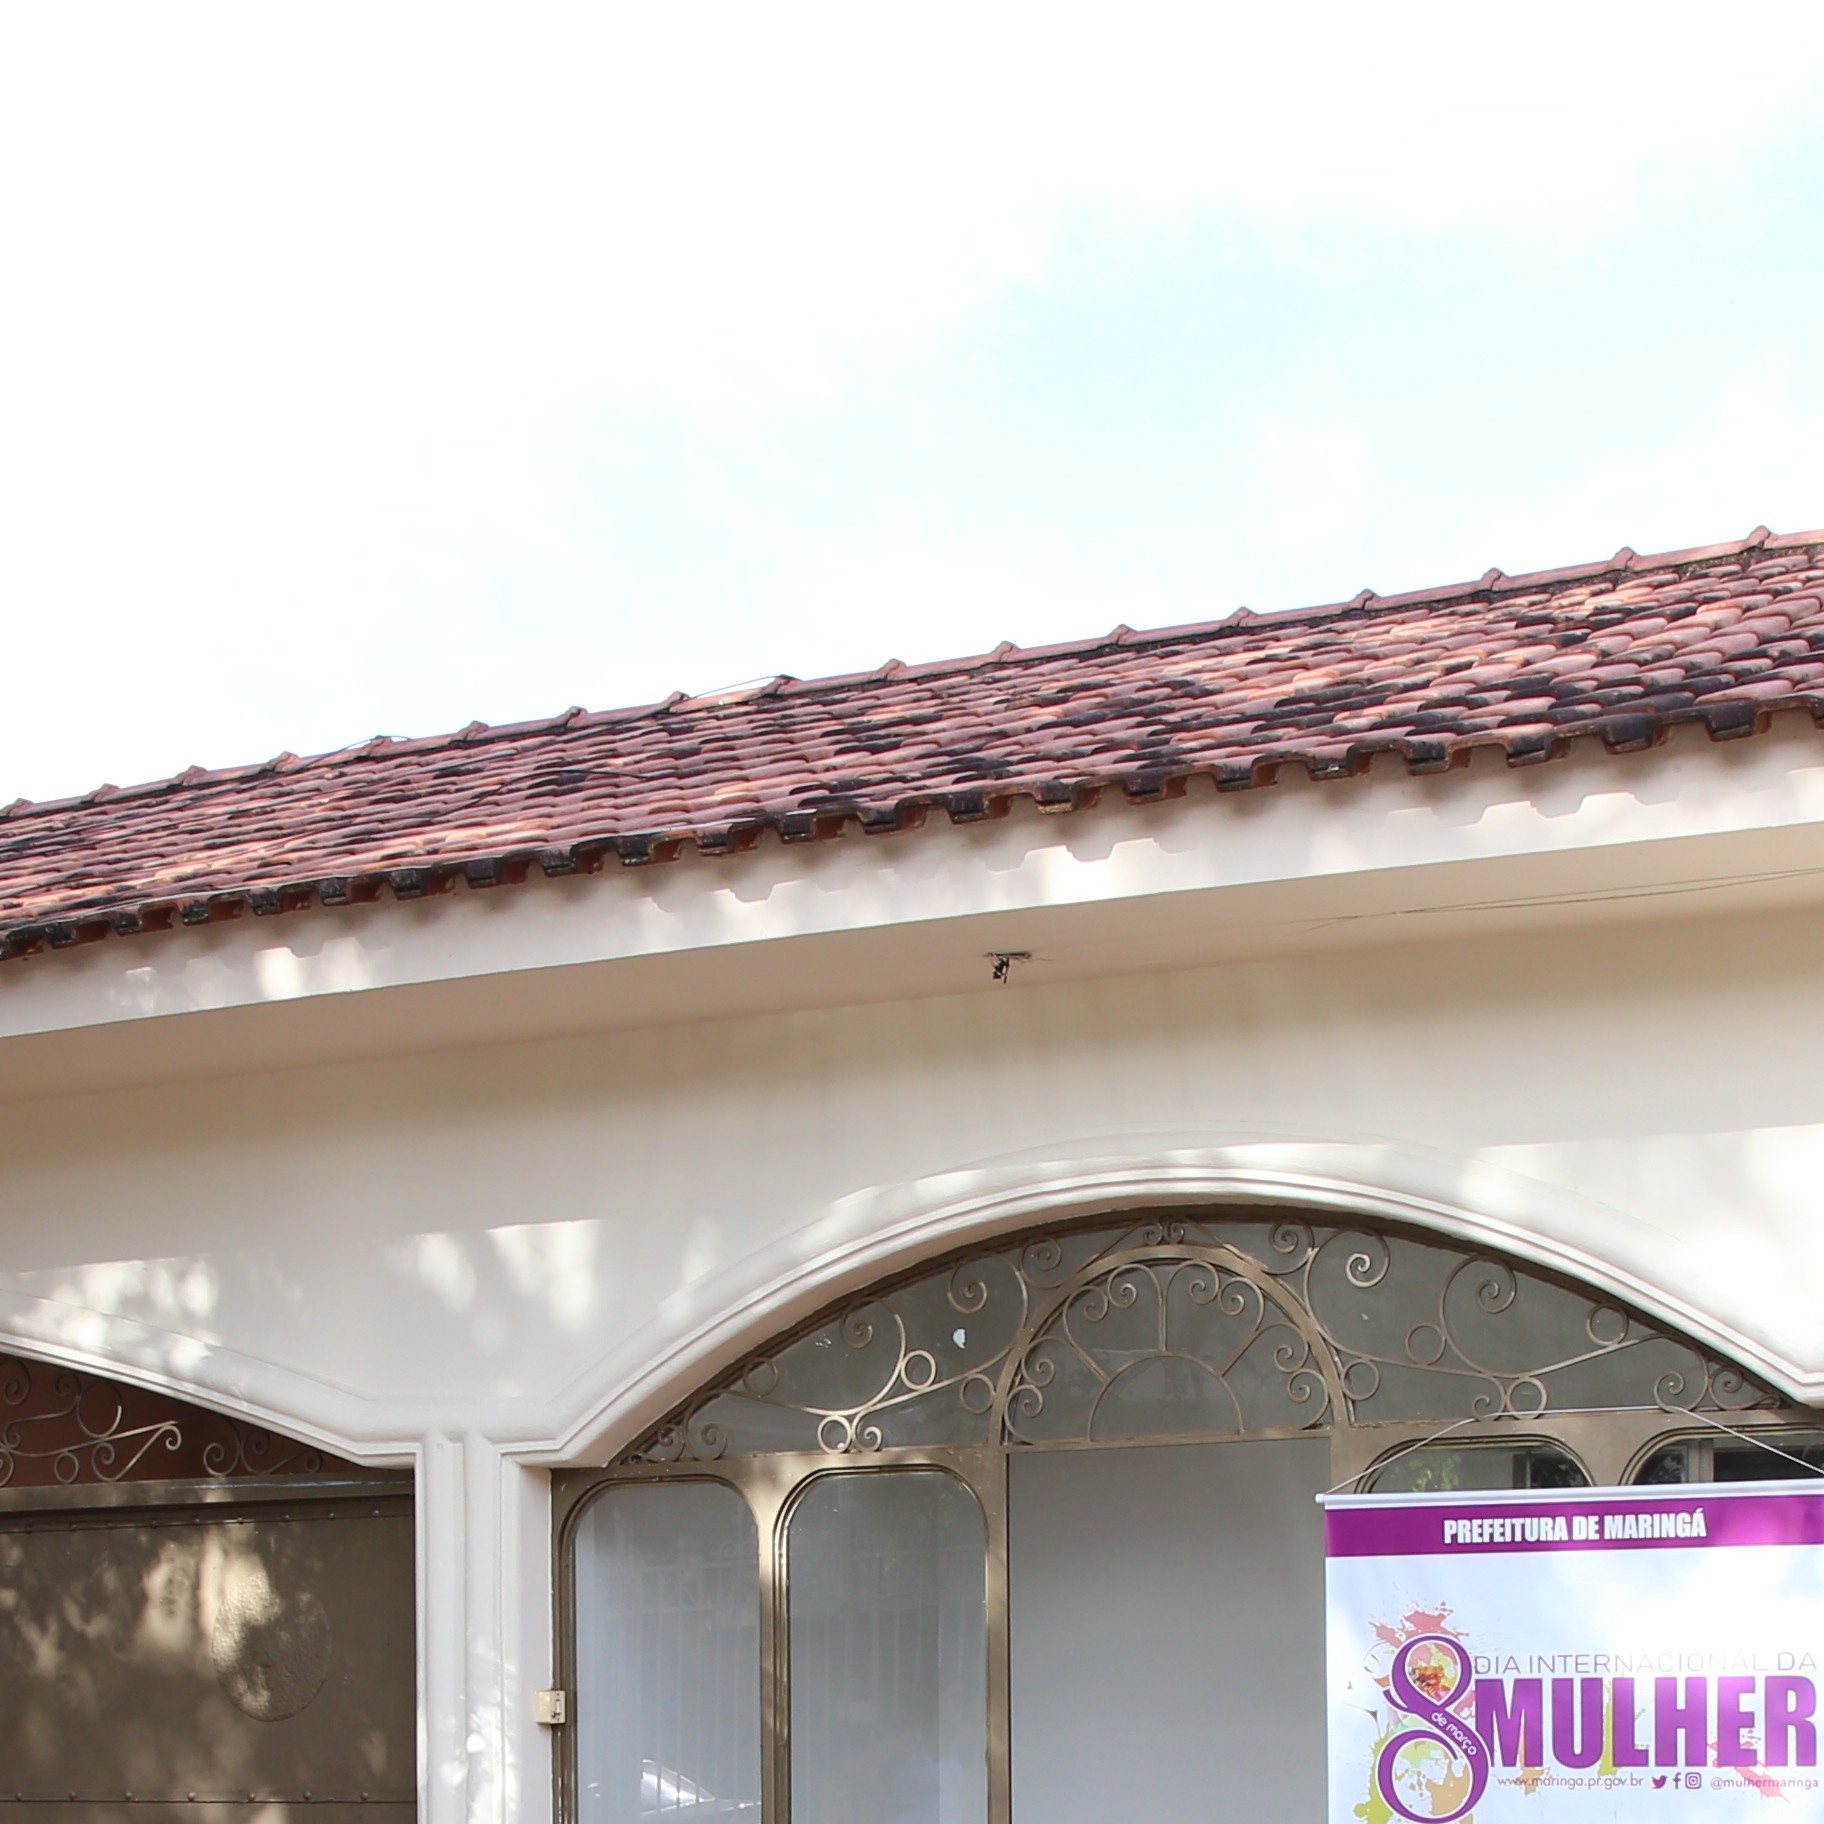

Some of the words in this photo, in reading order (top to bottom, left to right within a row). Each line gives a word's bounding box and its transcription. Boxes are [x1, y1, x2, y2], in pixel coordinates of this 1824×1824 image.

[1443, 1516, 1569, 1544] PREFEITURA
[1572, 1515, 1600, 1540] DE
[1604, 1507, 1707, 1540] MARINGÁ
[1474, 1655, 1521, 1675] DIA
[1529, 1653, 1769, 1674] INTERNACIONAL
[1778, 1652, 1818, 1671] DA
[1377, 1635, 1490, 1824] 8
[1431, 1712, 1447, 1727] de
[1446, 1723, 1478, 1756] março
[1475, 1675, 1817, 1769] MULHER
[1497, 1773, 1644, 1789] www.maringa.pr.gov.br
[1710, 1776, 1819, 1790] @mulhermaringa
